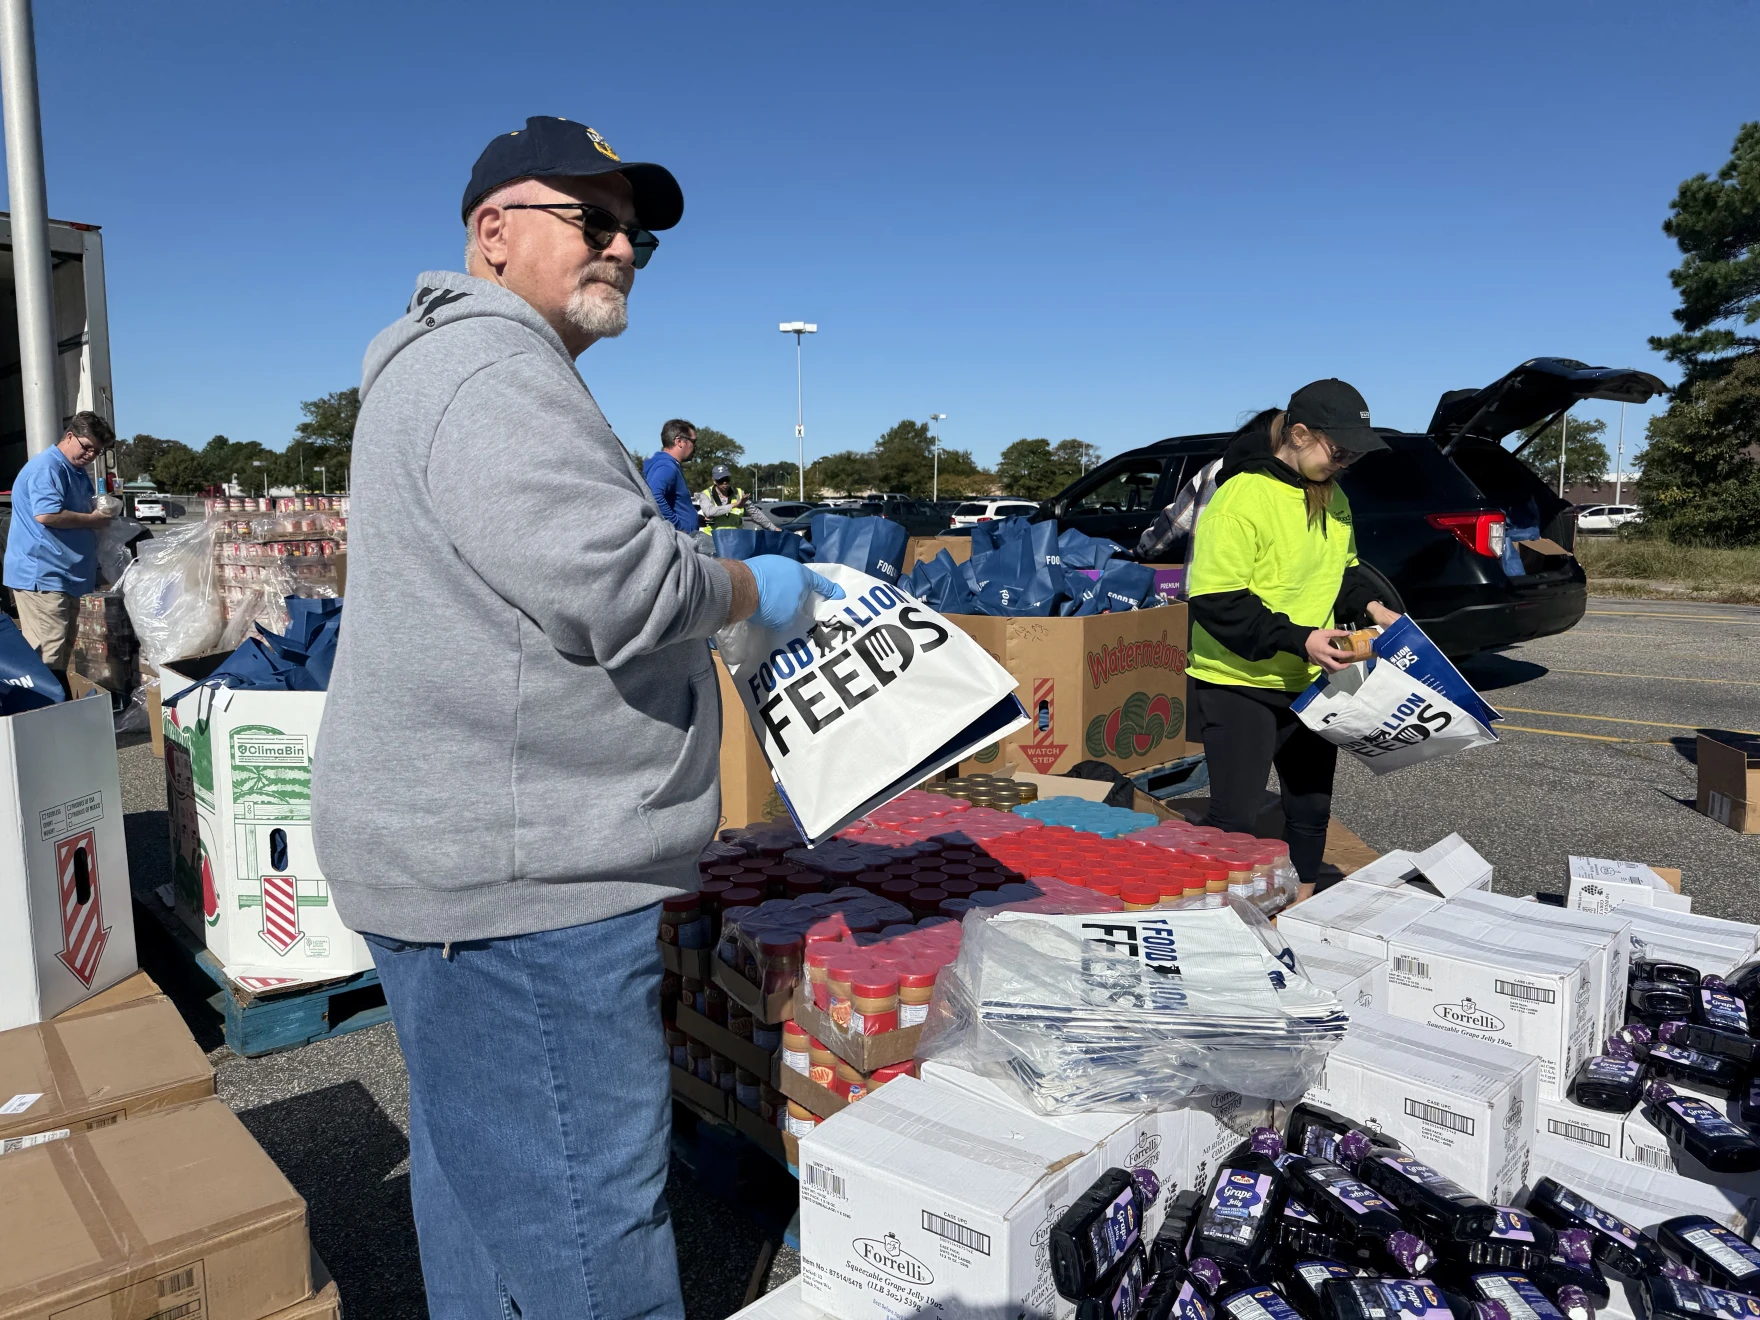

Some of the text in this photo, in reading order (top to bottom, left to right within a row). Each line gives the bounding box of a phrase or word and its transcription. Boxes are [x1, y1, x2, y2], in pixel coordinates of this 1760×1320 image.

[1045, 556, 1060, 565] FOO
[1160, 582, 1180, 590] PREMIUM
[1087, 630, 1187, 690] Watermelons
[1394, 646, 1411, 660] LION
[748, 637, 814, 705] FOOD
[759, 606, 949, 757] FEEDS
[1383, 693, 1426, 731] LION
[1350, 703, 1452, 758] EEDS
[248, 745, 304, 756] ClimaBin
[1027, 747, 1060, 756] WATCH
[1032, 756, 1055, 764] STEP
[1142, 926, 1178, 962] FOOD
[1442, 1006, 1495, 1029] Forrelli
[1426, 1020, 1460, 1034] Squeezable
[1460, 1029, 1480, 1039] Grape
[1481, 1034, 1496, 1043] Jelly
[1128, 1138, 1157, 1166] Forrelli
[1224, 1186, 1252, 1199] Grape
[1226, 1199, 1242, 1207] Jelly
[944, 1212, 968, 1225] CASE UPC
[1117, 1210, 1127, 1242] Grape
[802, 1256, 815, 1267] Item
[863, 1242, 922, 1282] Forrelli
[846, 1260, 883, 1283] Squeezable
[884, 1278, 906, 1293] Grape
[906, 1288, 926, 1303] Jelly
[904, 1296, 922, 1312] 539g
[1400, 1284, 1422, 1308] Grape
